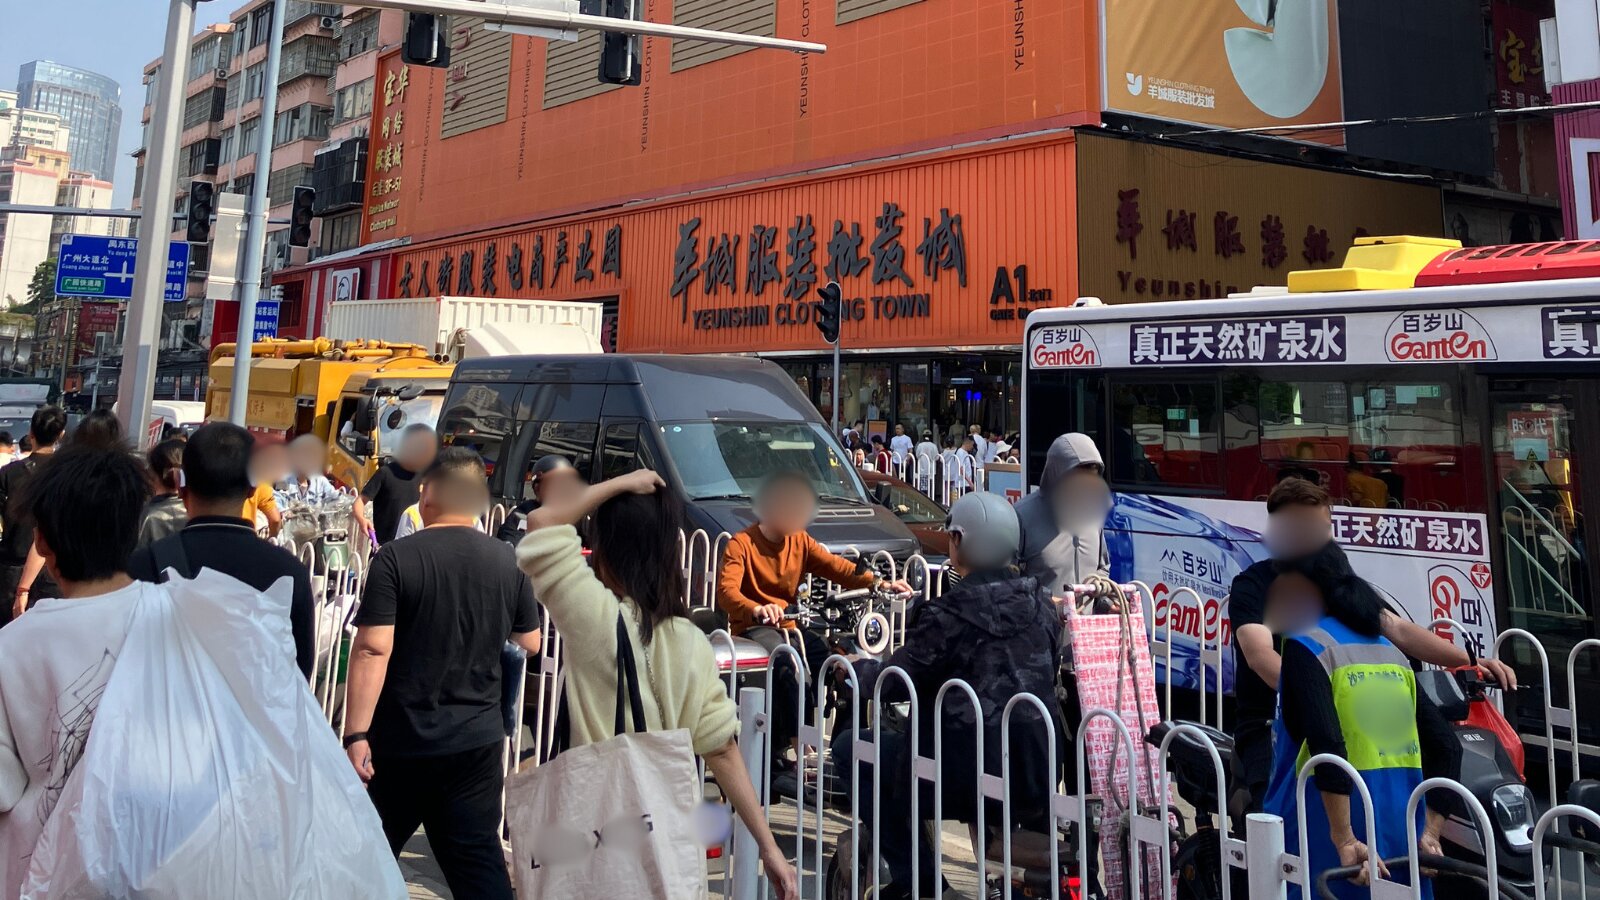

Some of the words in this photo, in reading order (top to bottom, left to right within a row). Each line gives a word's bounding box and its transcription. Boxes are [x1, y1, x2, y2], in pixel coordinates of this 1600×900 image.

[800, 52, 809, 118] YEUNSHI
[1147, 84, 1215, 109] 羊城服装批发城
[517, 121, 526, 180] YEUNSHIN
[522, 59, 531, 117] CLOTHING
[641, 86, 651, 153] YEUNSHIN
[108, 239, 138, 250] 禺东西
[1116, 188, 1370, 269] 羊城服装批
[63, 253, 110, 265] 广州大道北
[670, 202, 968, 323] 羊城服装批发城
[990, 265, 1027, 304] A1
[692, 304, 770, 330] YEUNSHIN
[774, 299, 866, 326] CLOTNG
[870, 293, 930, 320] TOWN
[1403, 312, 1463, 333] 百岁山
[1042, 328, 1082, 344] 百岁山
[1133, 319, 1343, 363] 真正天然矿泉水
[1549, 309, 1600, 356] 真
[1182, 550, 1222, 584] 百岁山
